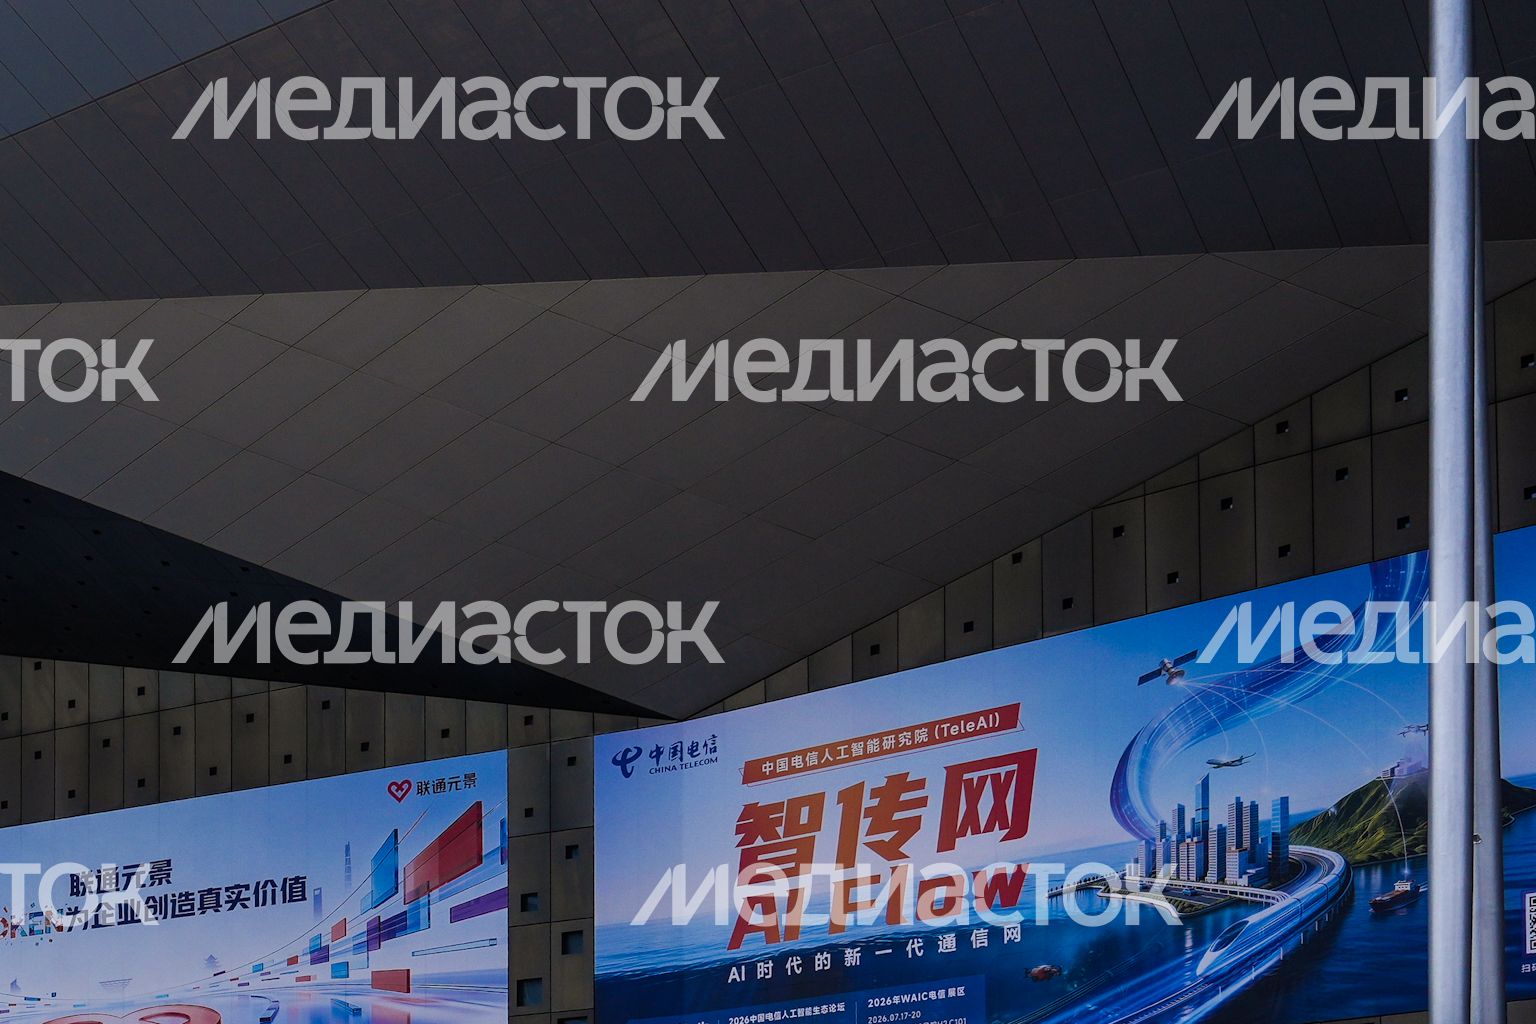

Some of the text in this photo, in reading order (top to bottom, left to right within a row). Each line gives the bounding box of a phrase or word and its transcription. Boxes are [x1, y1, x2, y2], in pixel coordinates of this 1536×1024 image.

[648, 733, 719, 763] 中国电信
[760, 727, 929, 775] 中国电信人工智能研究院
[649, 757, 718, 775] CHINA TELECOM
[415, 771, 478, 798] 联通元景
[735, 747, 1039, 886] 智传网
[69, 858, 173, 898] 联通元景
[867, 1010, 922, 1024] 2026.07.17-20
